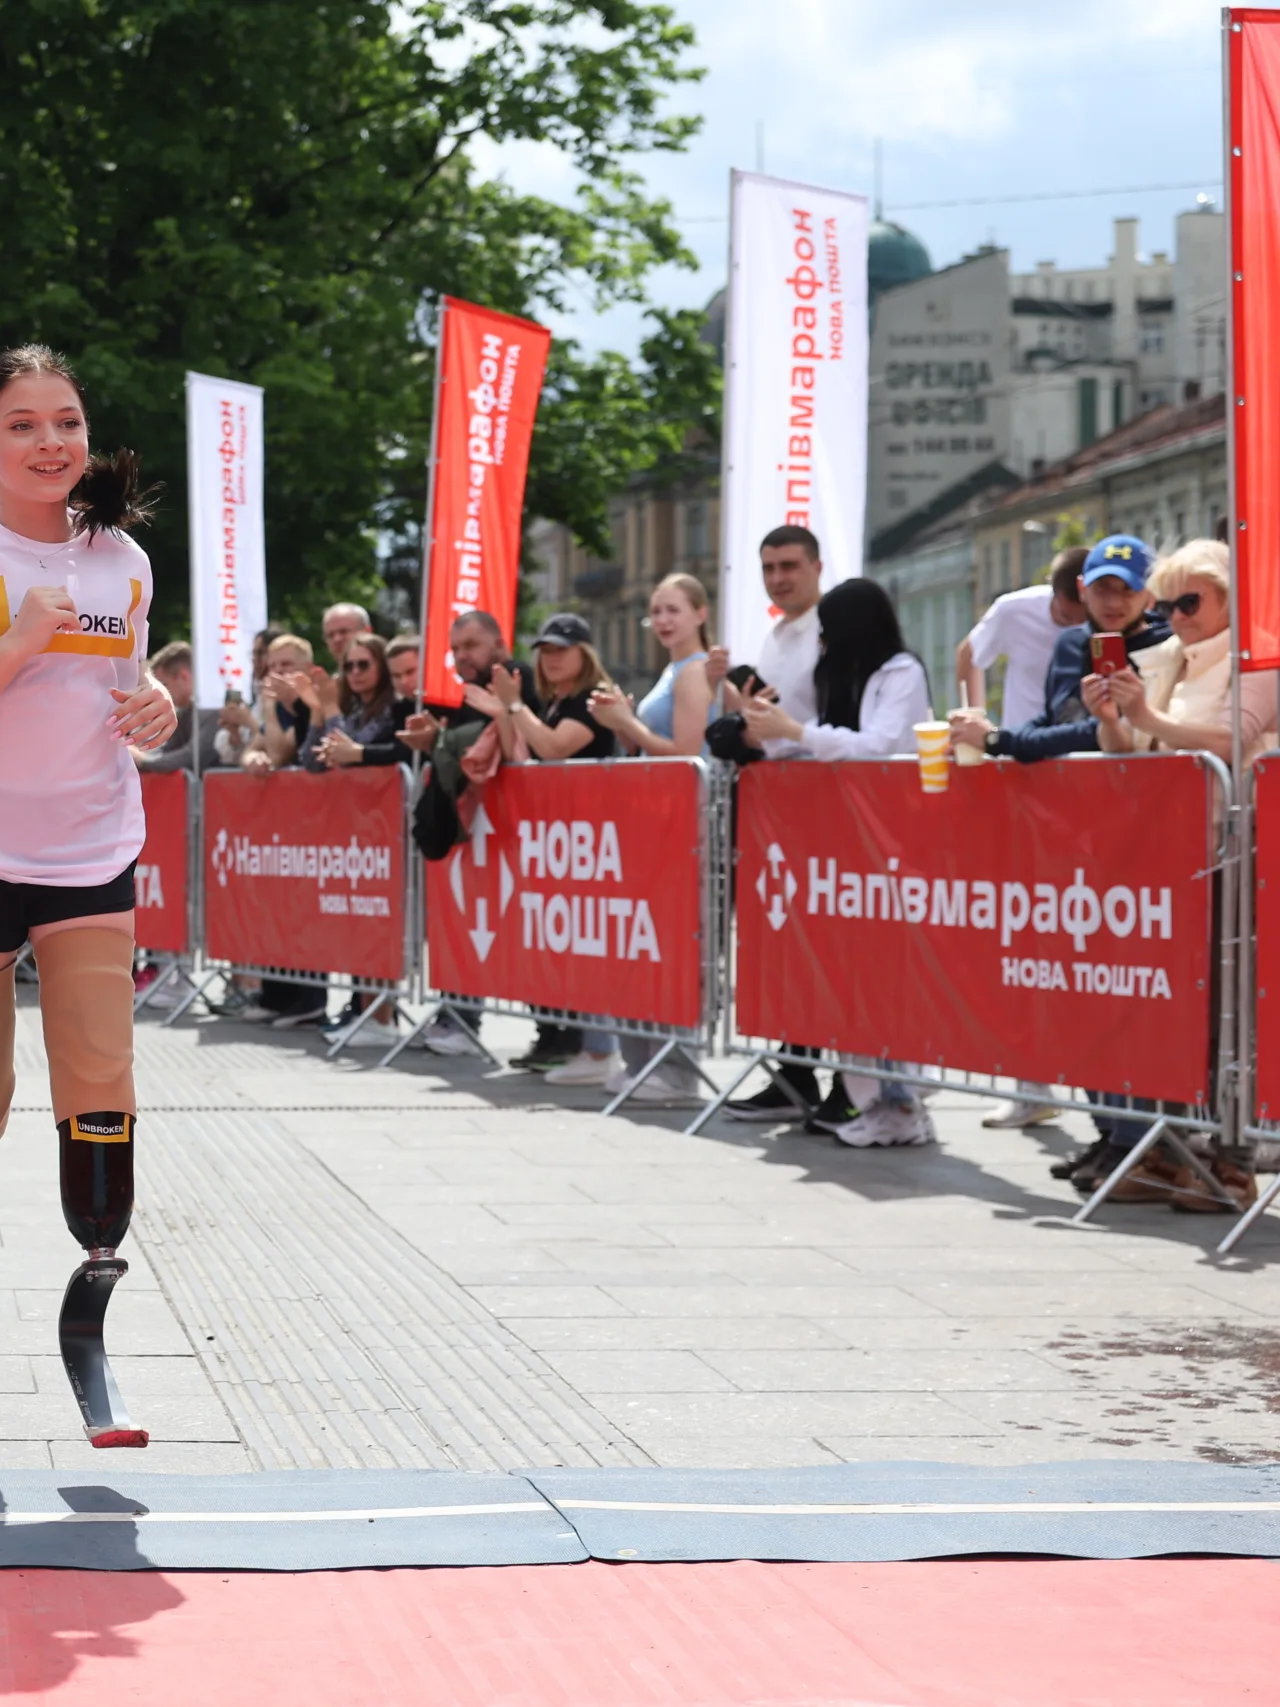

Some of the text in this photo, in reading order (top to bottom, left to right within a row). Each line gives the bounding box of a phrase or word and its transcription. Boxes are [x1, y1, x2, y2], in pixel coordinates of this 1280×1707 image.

[823, 217, 842, 360] НОВА ПОШТА
[777, 208, 823, 528] апівмарафон
[218, 400, 239, 645] Напівмарафон
[233, 833, 391, 890] Напівмарафон
[519, 820, 623, 883] НОВА
[521, 891, 661, 962] ПОШТА
[807, 856, 1173, 952] Напівмарафон
[1001, 956, 1172, 1000] НОВА ПОШТА
[78, 1122, 124, 1135] UNBROKEN
